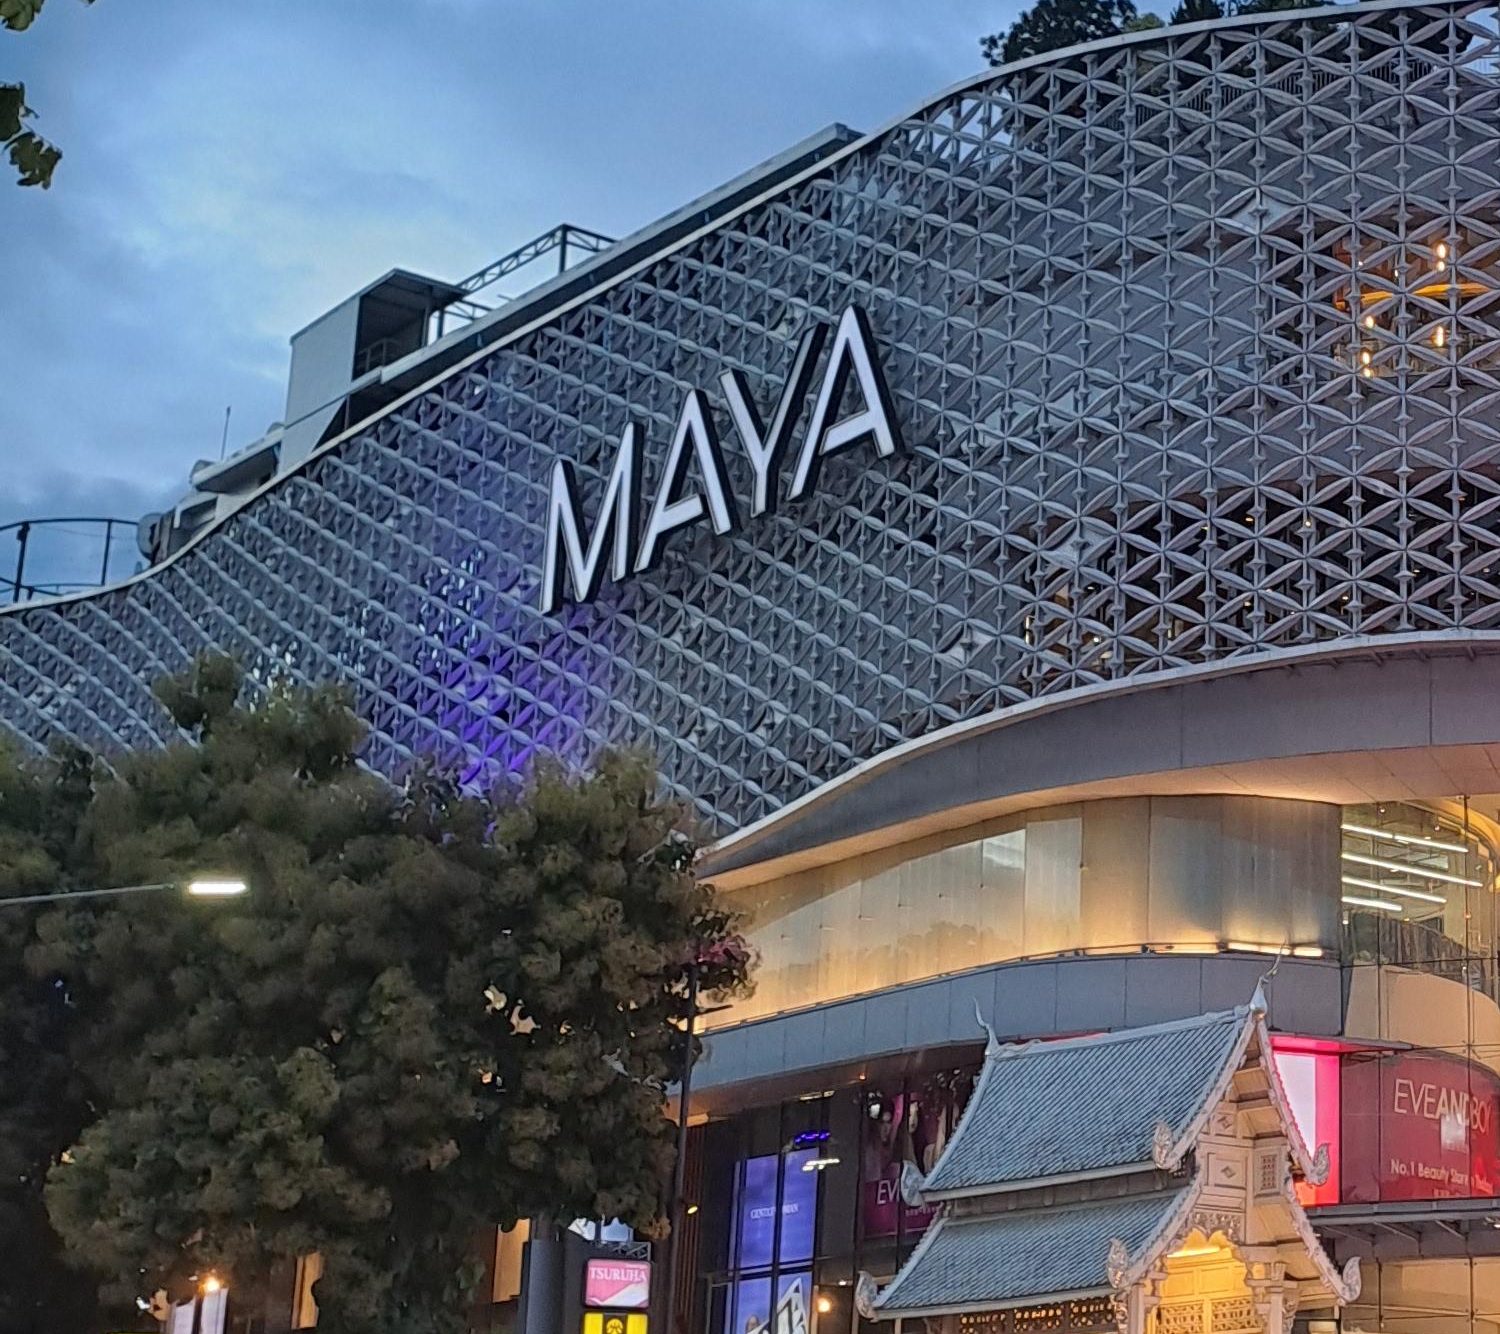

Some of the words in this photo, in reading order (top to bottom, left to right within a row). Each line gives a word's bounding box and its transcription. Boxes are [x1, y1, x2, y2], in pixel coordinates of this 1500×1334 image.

[540, 304, 902, 615] MAYA
[1394, 1078, 1492, 1135] EVEANDBOY
[590, 1267, 646, 1283] TSURUHA
